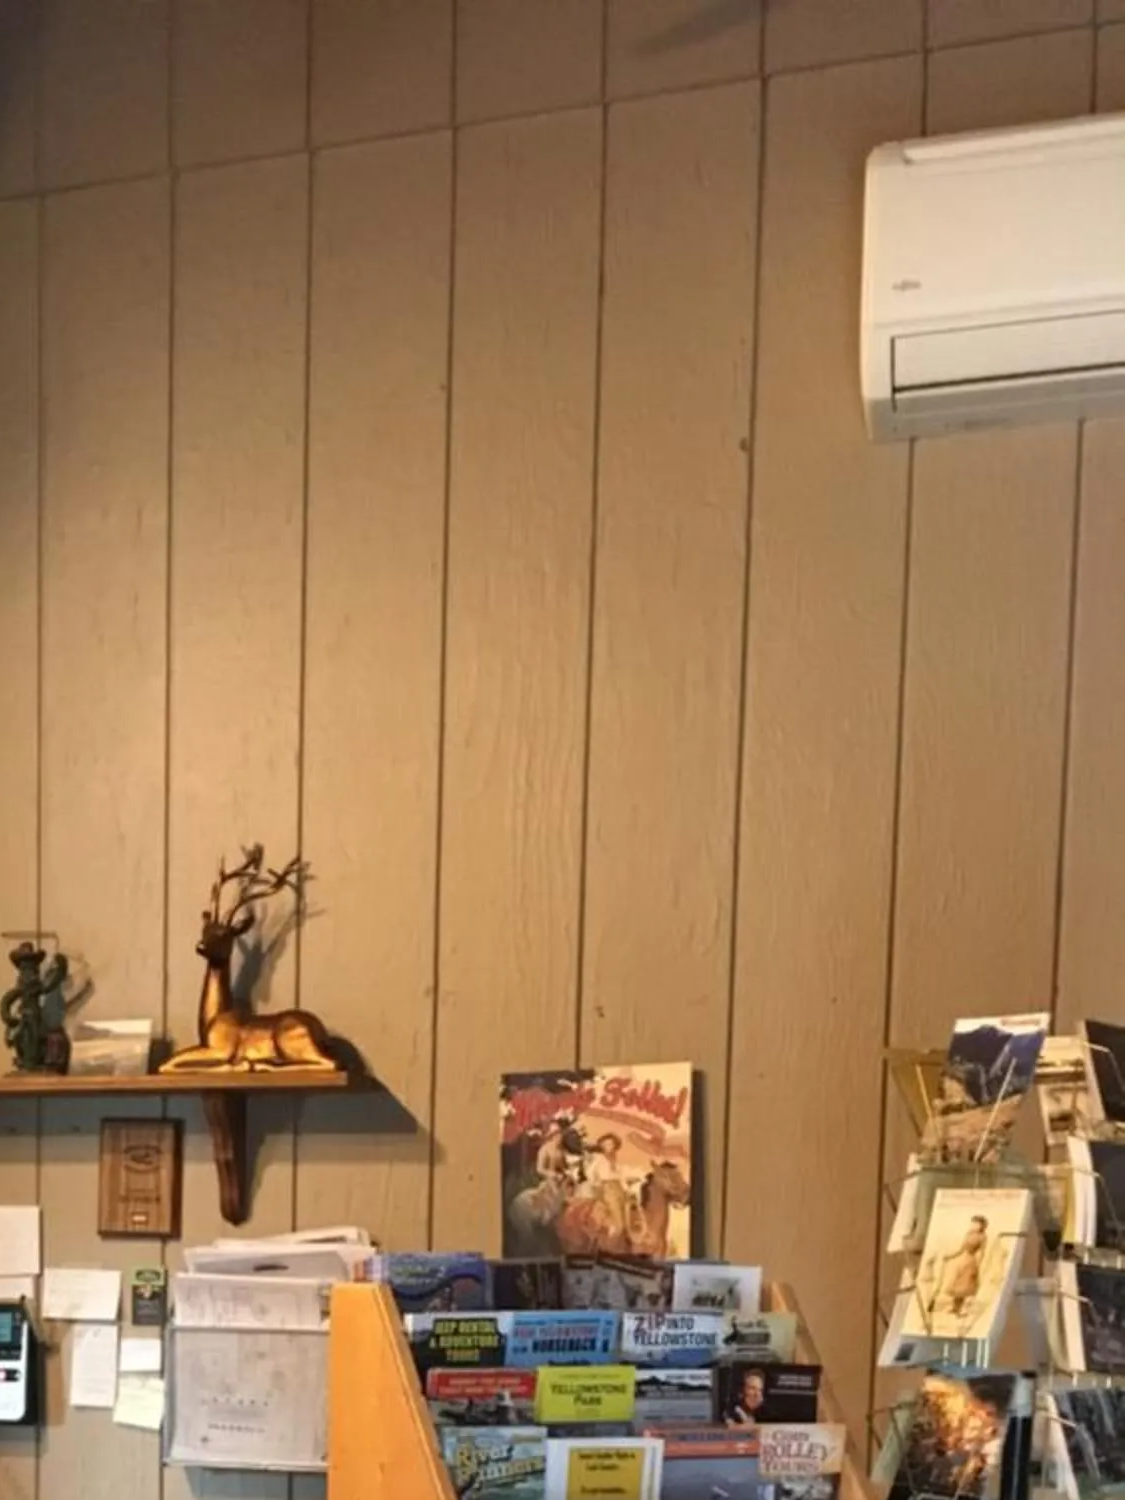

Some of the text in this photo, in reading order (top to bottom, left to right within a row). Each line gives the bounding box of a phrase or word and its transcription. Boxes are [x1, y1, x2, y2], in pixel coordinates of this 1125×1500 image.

[634, 1315, 695, 1332] ZIP INTO
[633, 1331, 718, 1347] YELLOWSTONE
